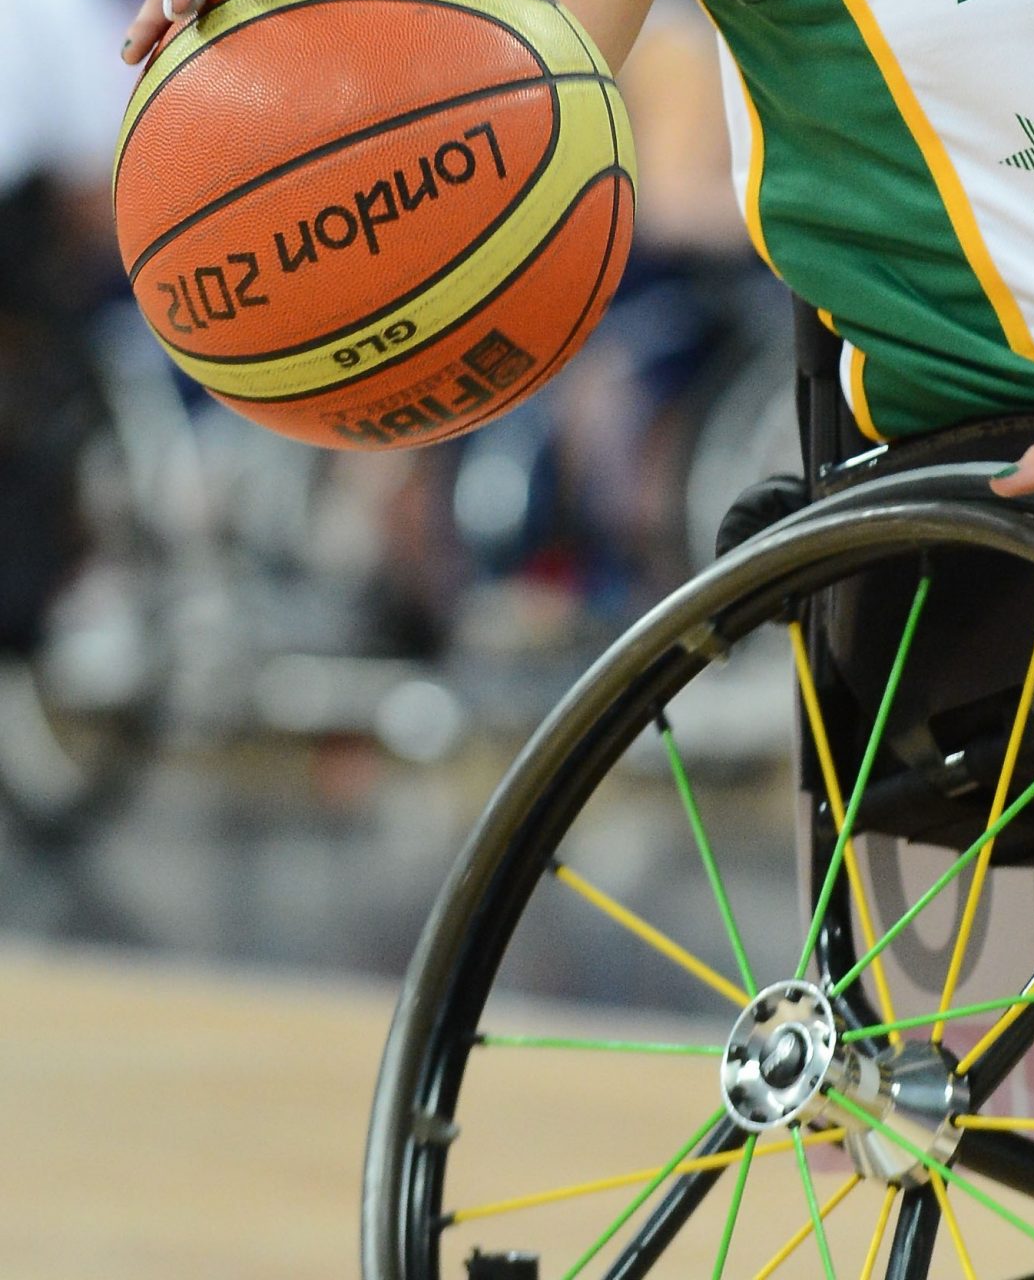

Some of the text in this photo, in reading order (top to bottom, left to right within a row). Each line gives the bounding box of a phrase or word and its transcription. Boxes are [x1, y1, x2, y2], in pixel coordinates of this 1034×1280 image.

[157, 122, 507, 334] London 2012
[333, 321, 416, 369] GL6
